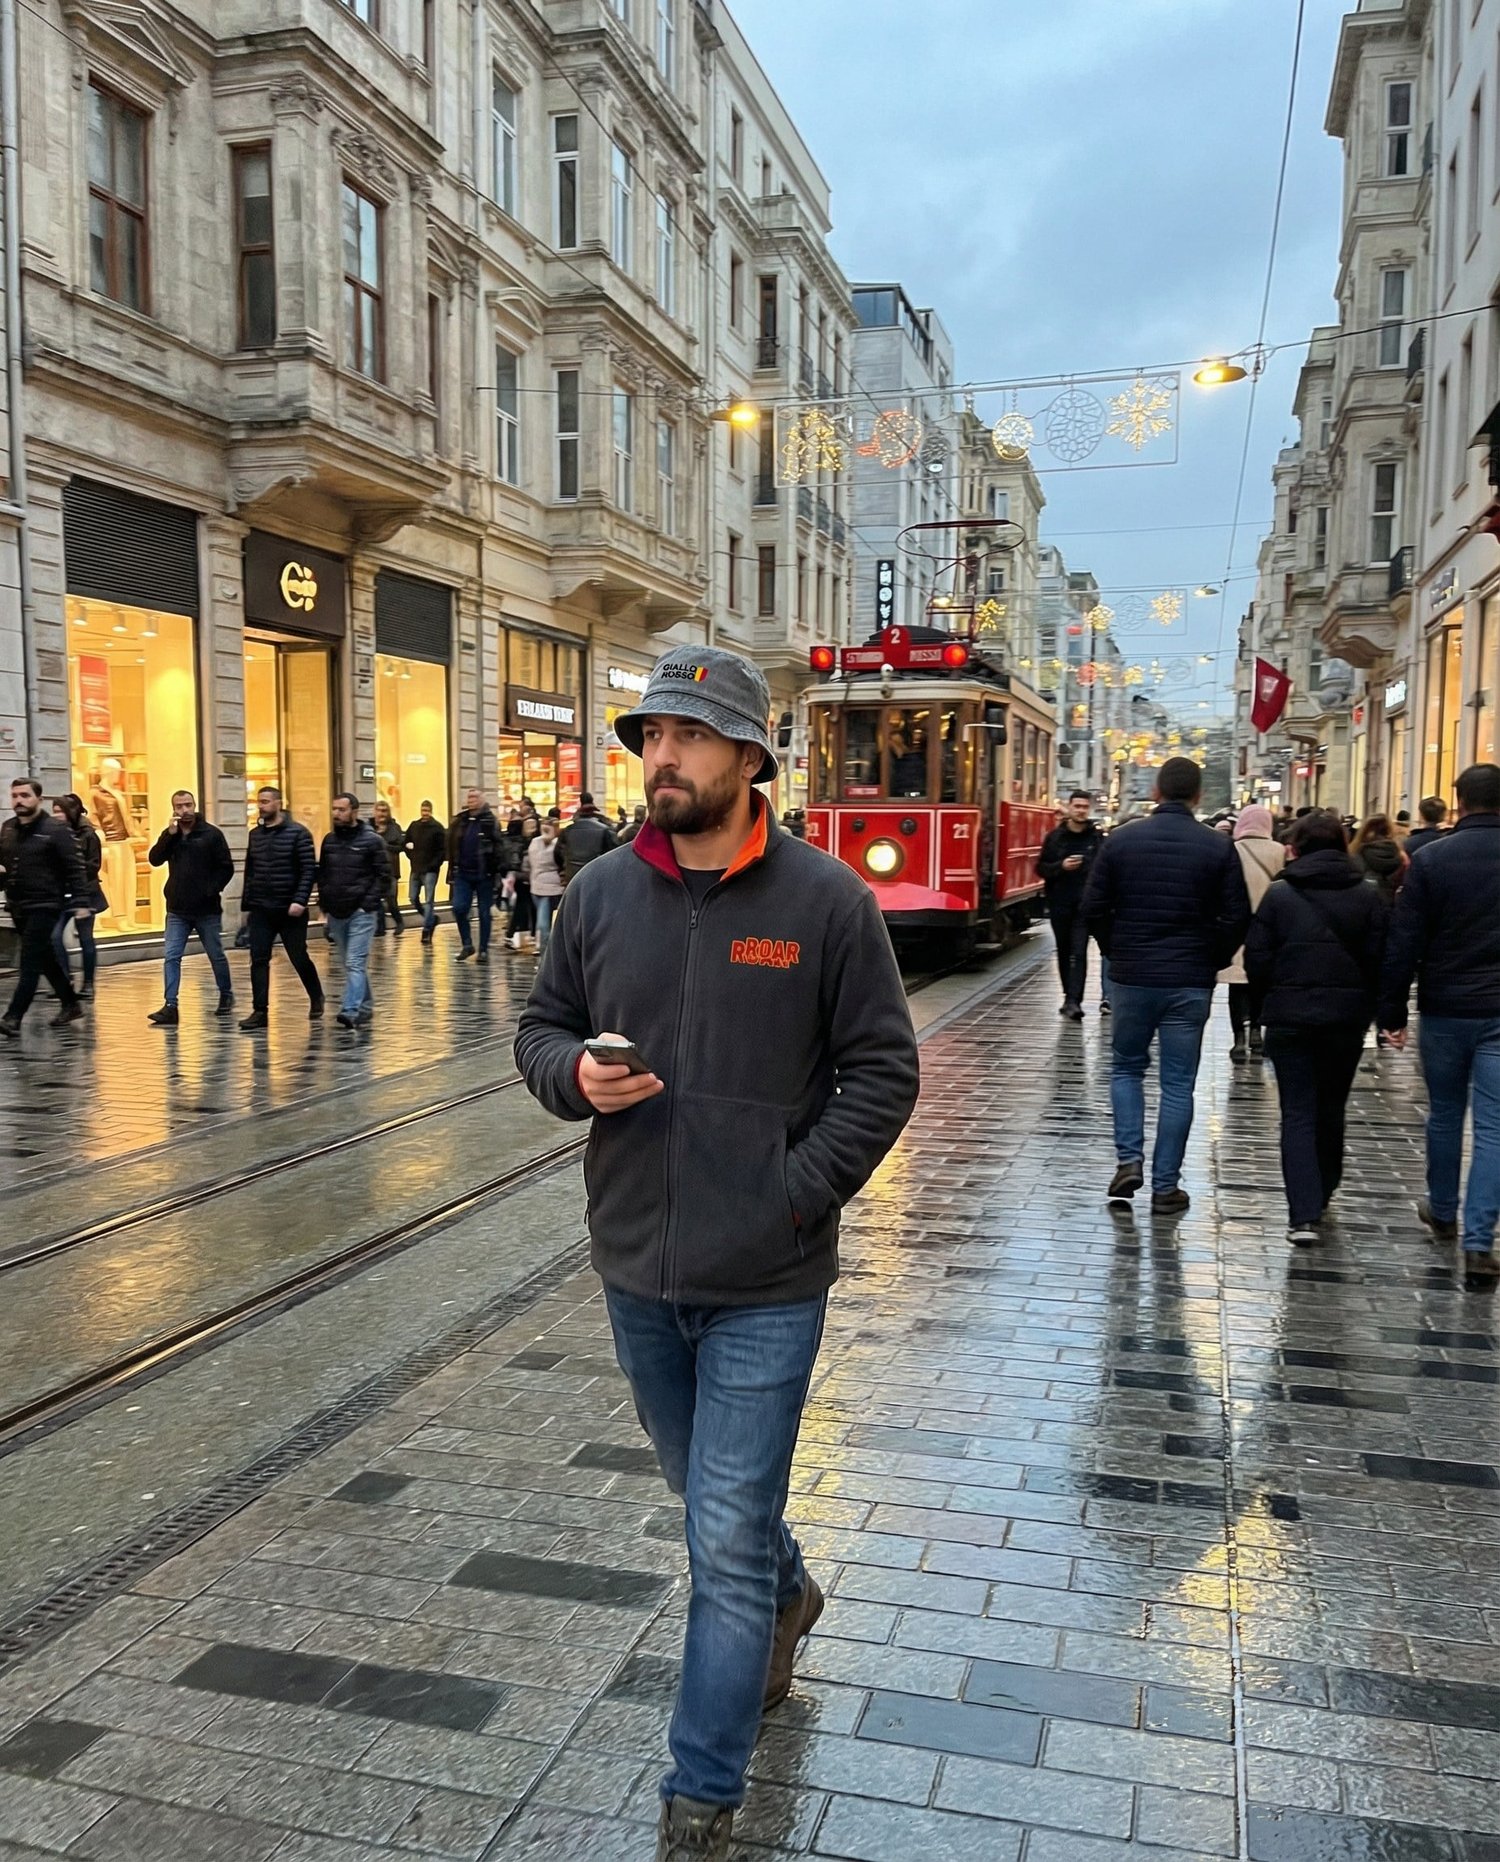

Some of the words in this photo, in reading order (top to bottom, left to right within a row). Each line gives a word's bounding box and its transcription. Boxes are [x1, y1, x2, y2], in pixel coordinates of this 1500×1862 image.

[890, 628, 901, 644] 2
[662, 663, 698, 673] GIALLO
[661, 671, 696, 681] ROSSO
